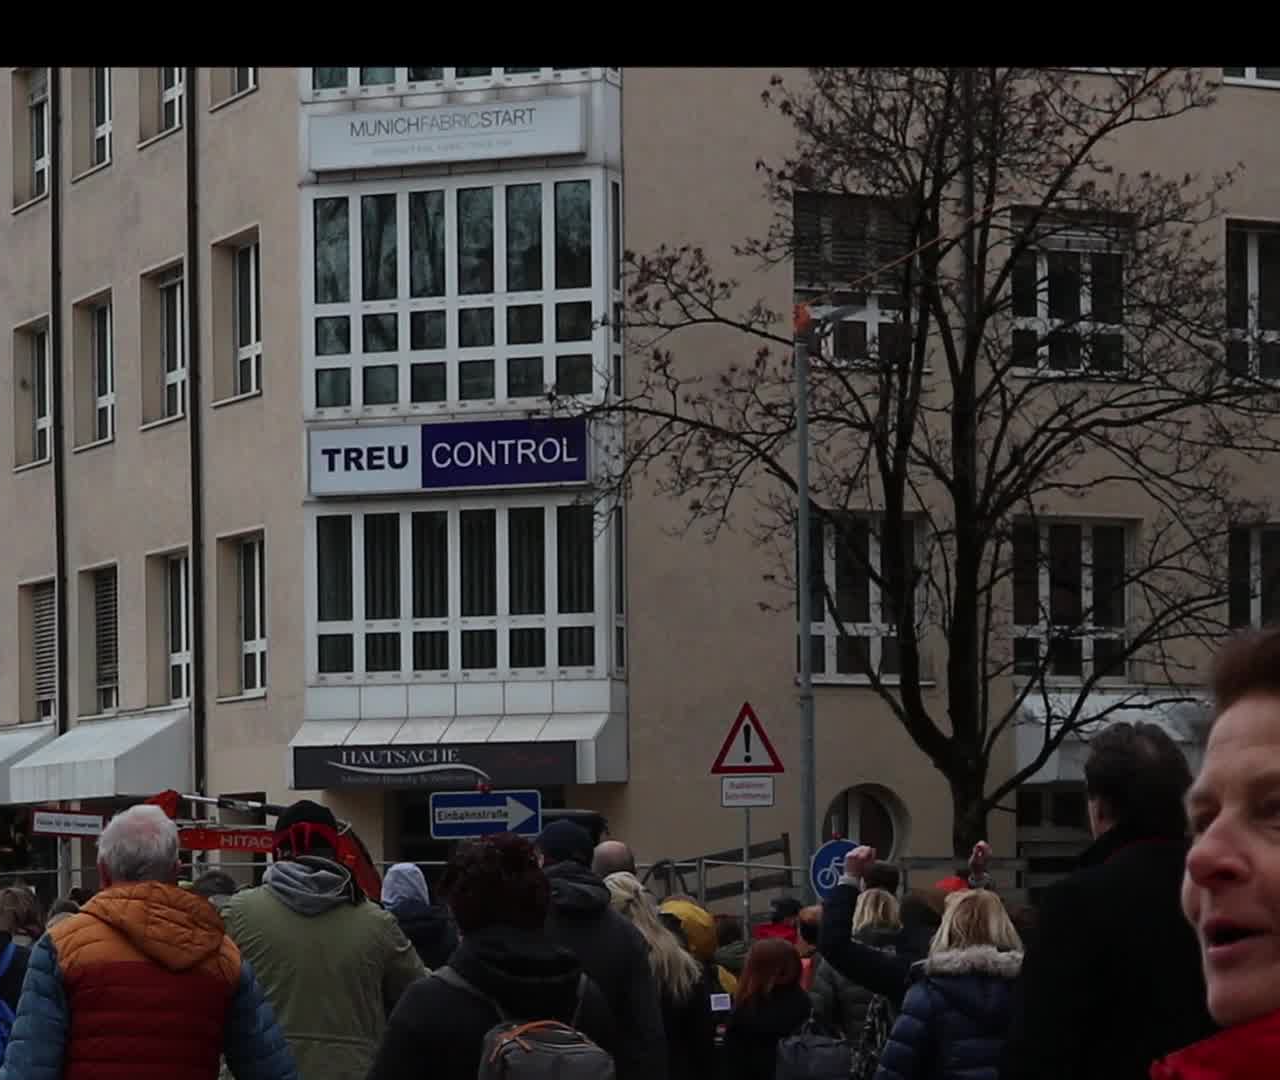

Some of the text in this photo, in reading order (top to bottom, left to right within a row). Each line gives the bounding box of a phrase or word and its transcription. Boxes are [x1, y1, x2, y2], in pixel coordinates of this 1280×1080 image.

[322, 437, 578, 472] TREU CONTROL
[340, 748, 460, 765] HAUTSACHE
[222, 834, 273, 850] HITAC
